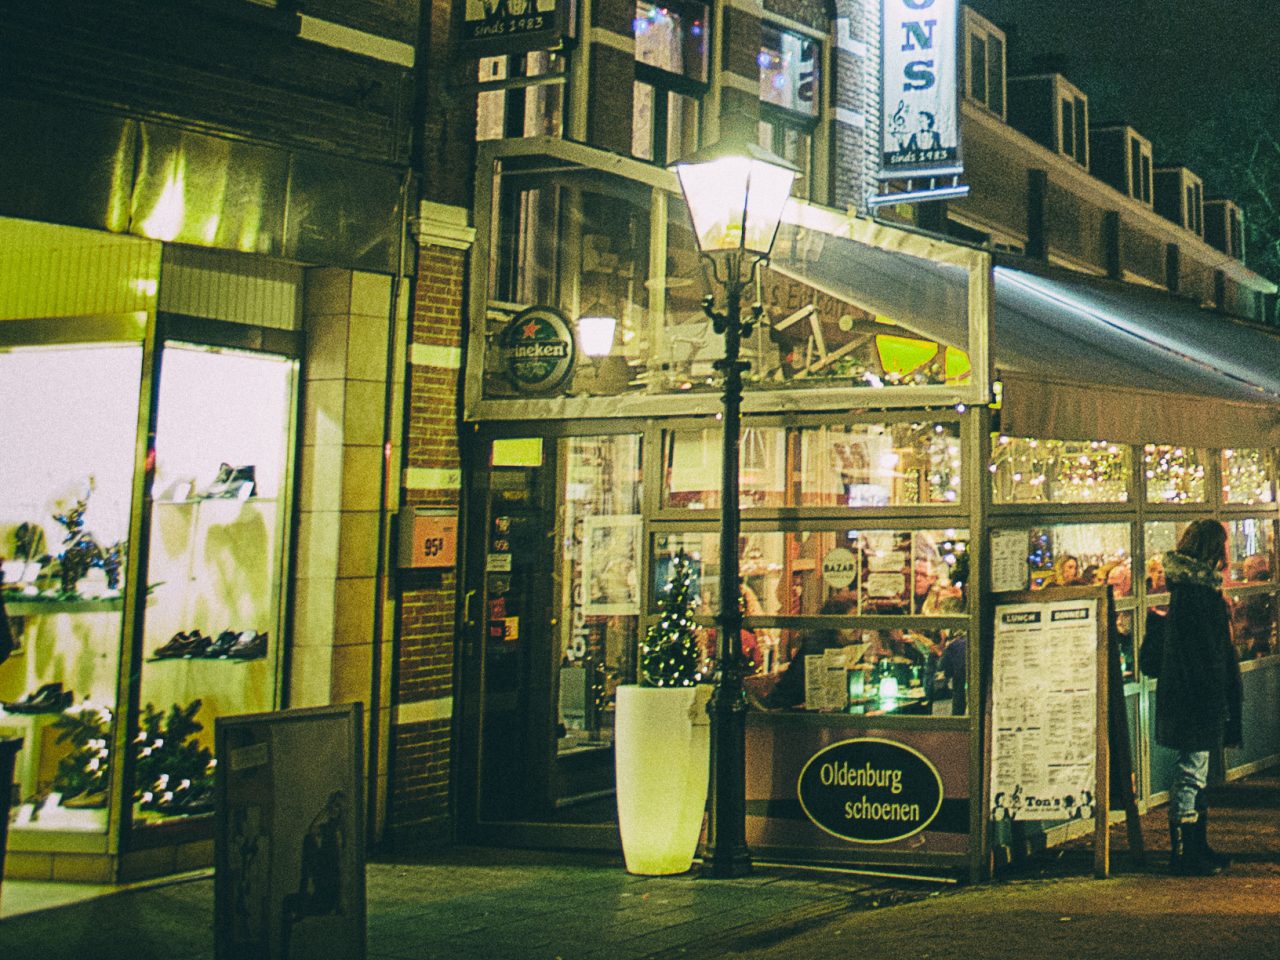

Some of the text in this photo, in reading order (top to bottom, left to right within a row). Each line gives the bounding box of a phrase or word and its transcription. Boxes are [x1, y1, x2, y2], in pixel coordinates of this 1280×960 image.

[475, 16, 544, 36] sinds 1983
[508, 342, 566, 358] ineken
[820, 759, 903, 795] Oldenburg
[844, 795, 920, 822] schoenen
